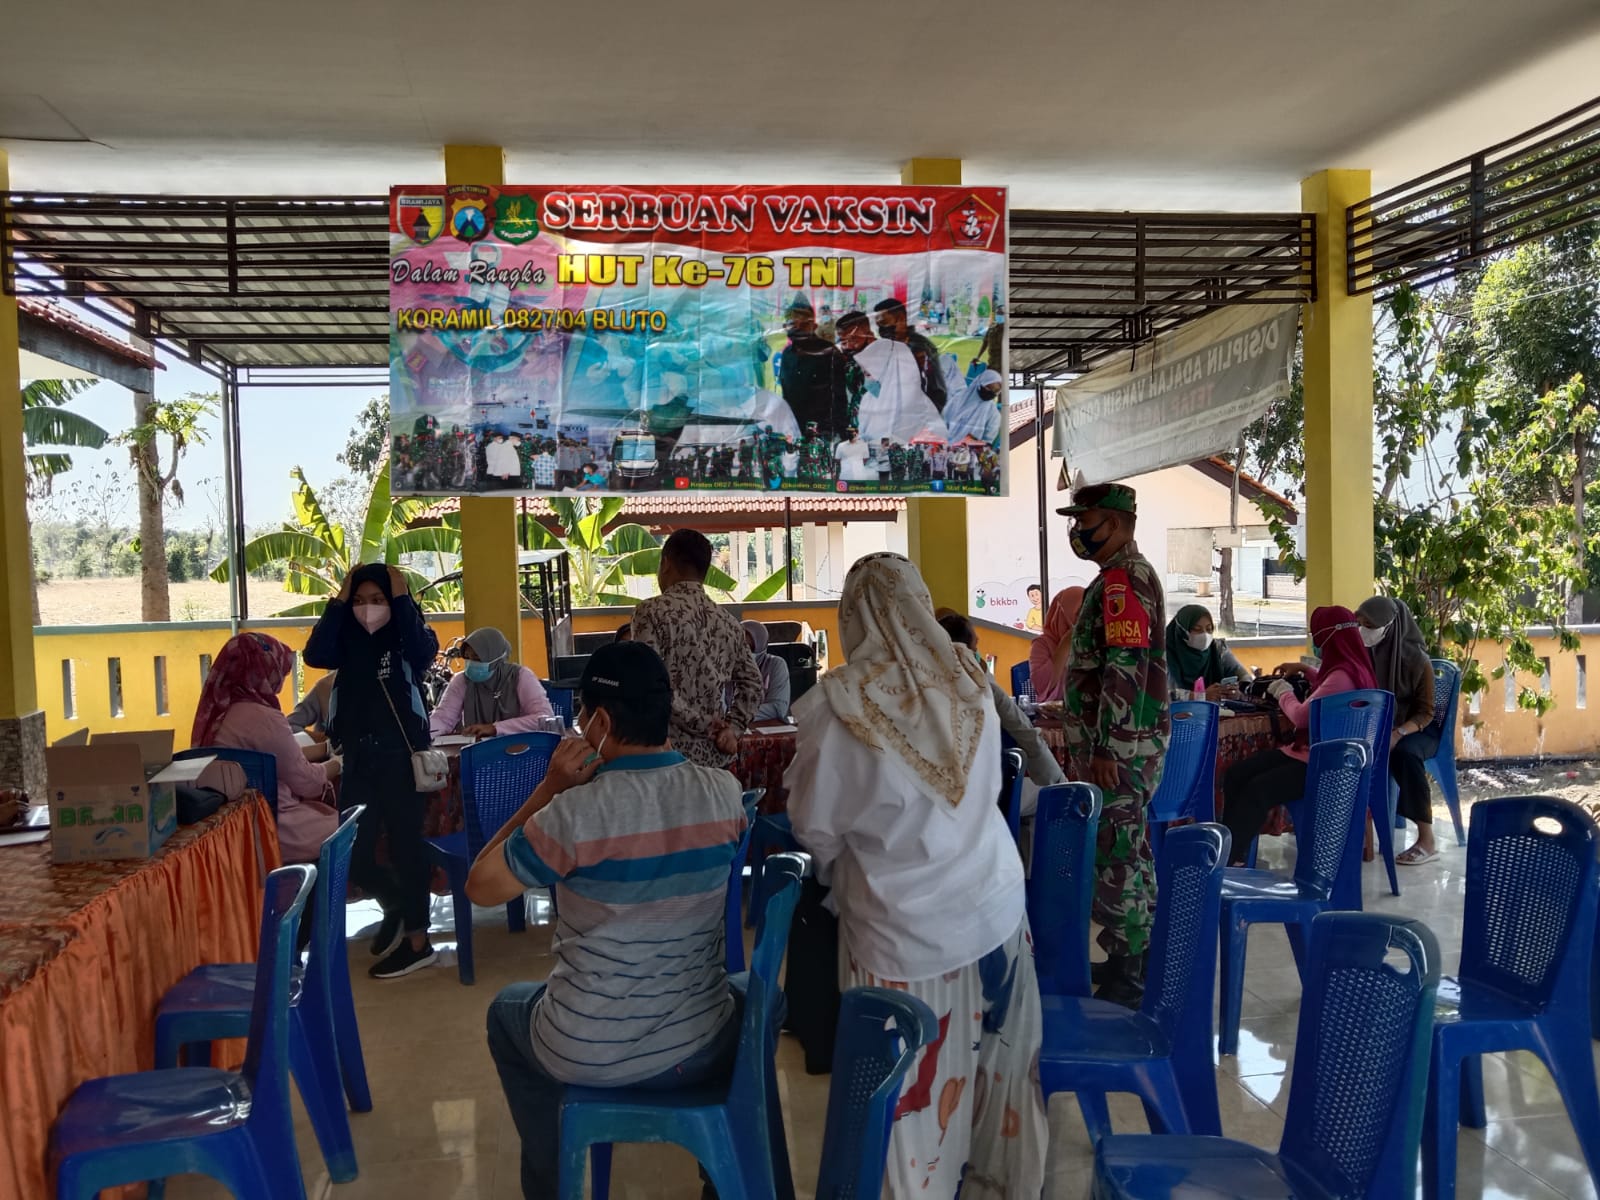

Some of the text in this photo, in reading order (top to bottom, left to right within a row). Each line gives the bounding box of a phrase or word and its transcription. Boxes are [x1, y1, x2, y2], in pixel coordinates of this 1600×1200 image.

[543, 192, 936, 236] SERBUAN VAKSIN
[392, 258, 546, 291] Dalam Rangka
[556, 254, 855, 289] HUT Ke-76 TNI
[398, 309, 668, 332] KORAMIL 0827/04 BLUTO
[990, 597, 1018, 606] bkkbn
